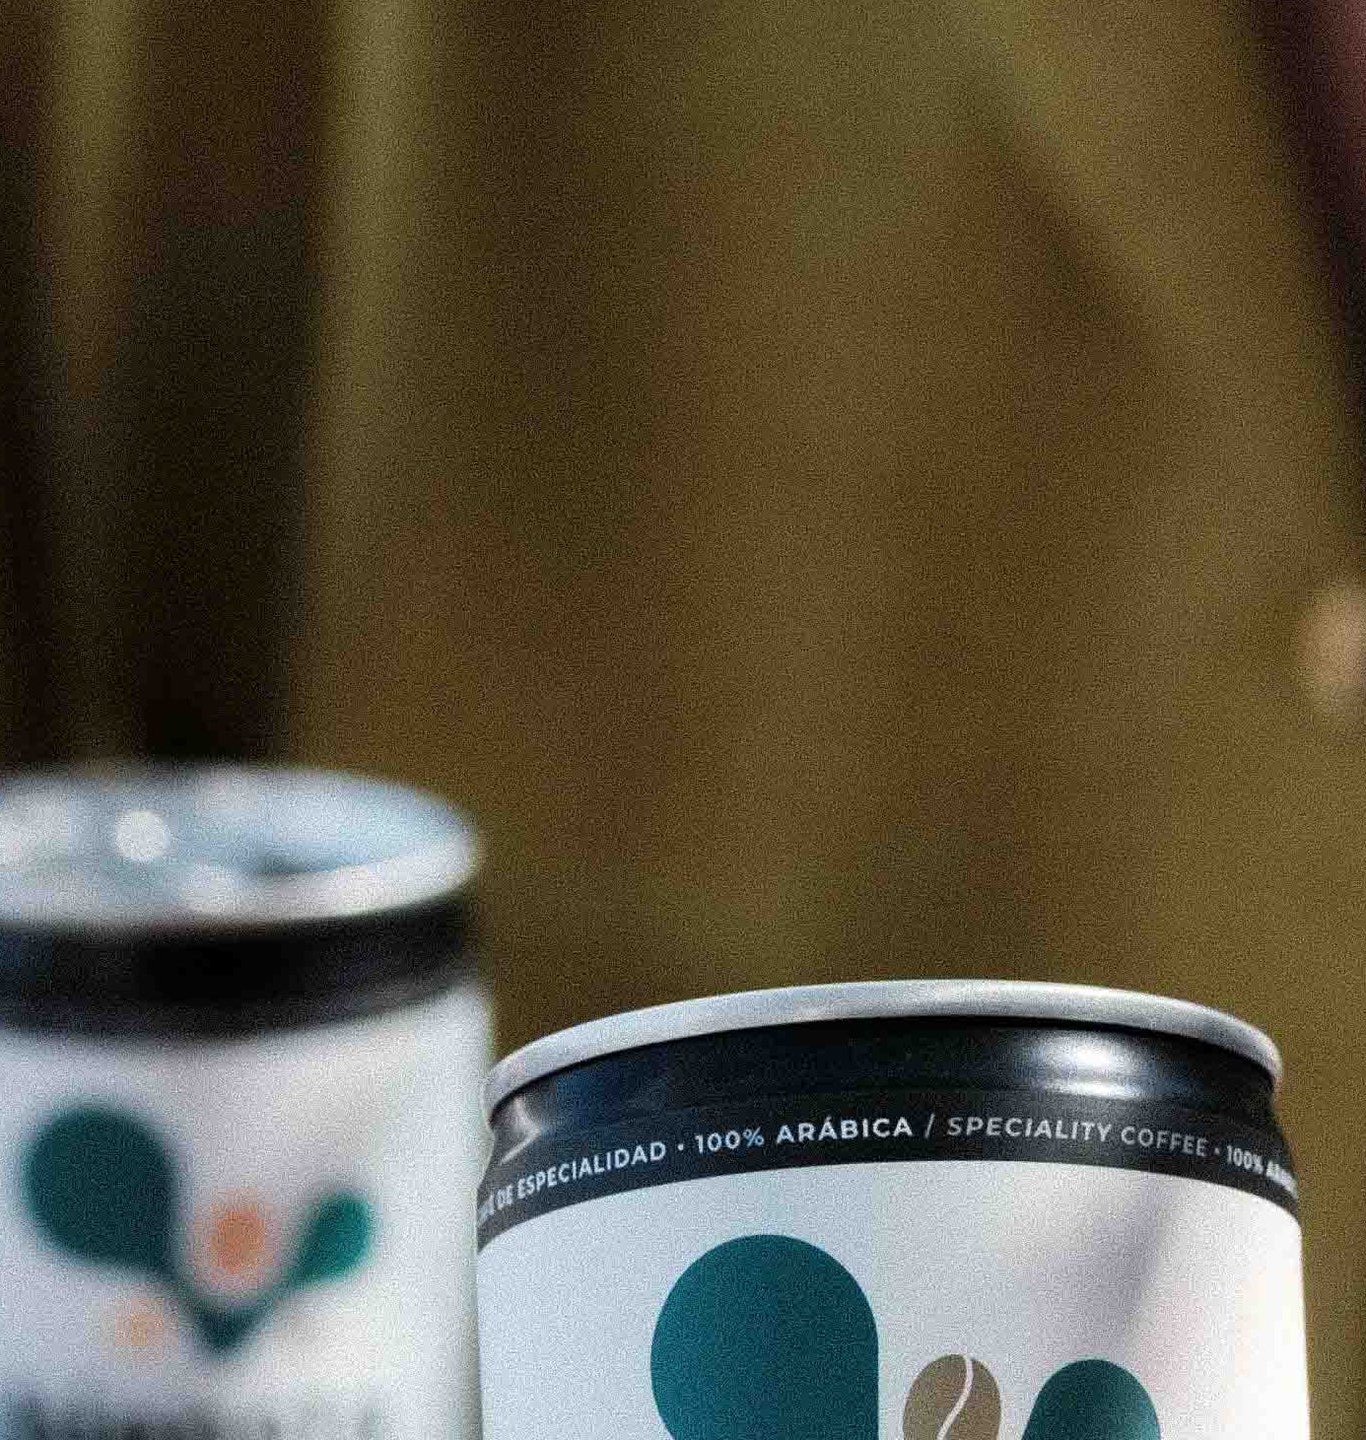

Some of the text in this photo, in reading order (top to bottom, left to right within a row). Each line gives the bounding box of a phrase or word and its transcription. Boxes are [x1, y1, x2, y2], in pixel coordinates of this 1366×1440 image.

[518, 1141, 666, 1200] ESPECIALIDAD
[694, 1126, 764, 1154] 100%
[776, 1116, 914, 1144] ARÁBICA
[946, 1117, 1112, 1143] SPECIALITY
[1120, 1126, 1209, 1157] COFFEE
